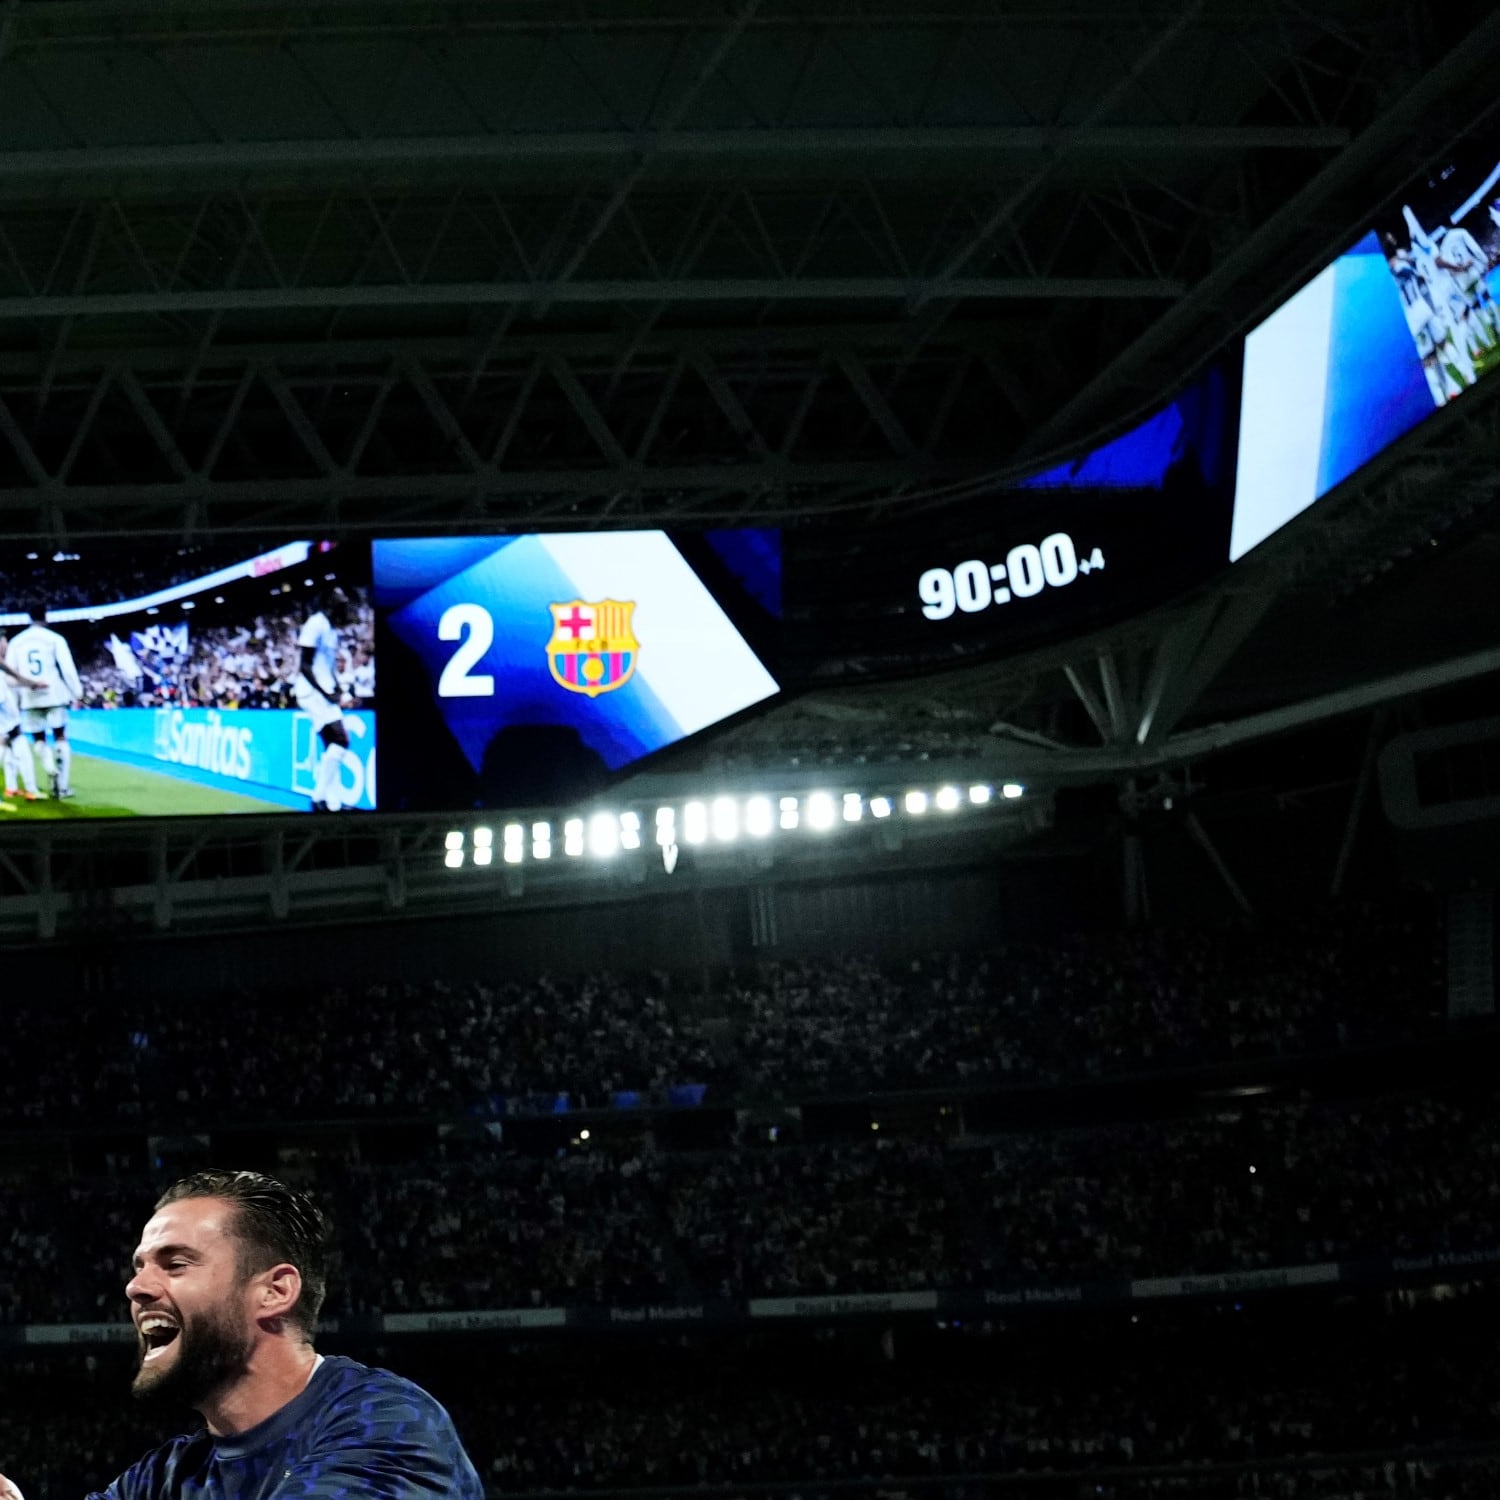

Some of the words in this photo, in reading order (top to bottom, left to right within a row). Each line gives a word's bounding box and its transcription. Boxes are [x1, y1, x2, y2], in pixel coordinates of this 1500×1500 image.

[919, 532, 1077, 620] 90:00
[27, 649, 43, 676] 5
[438, 604, 495, 698] 2
[169, 708, 252, 778] Sanitas
